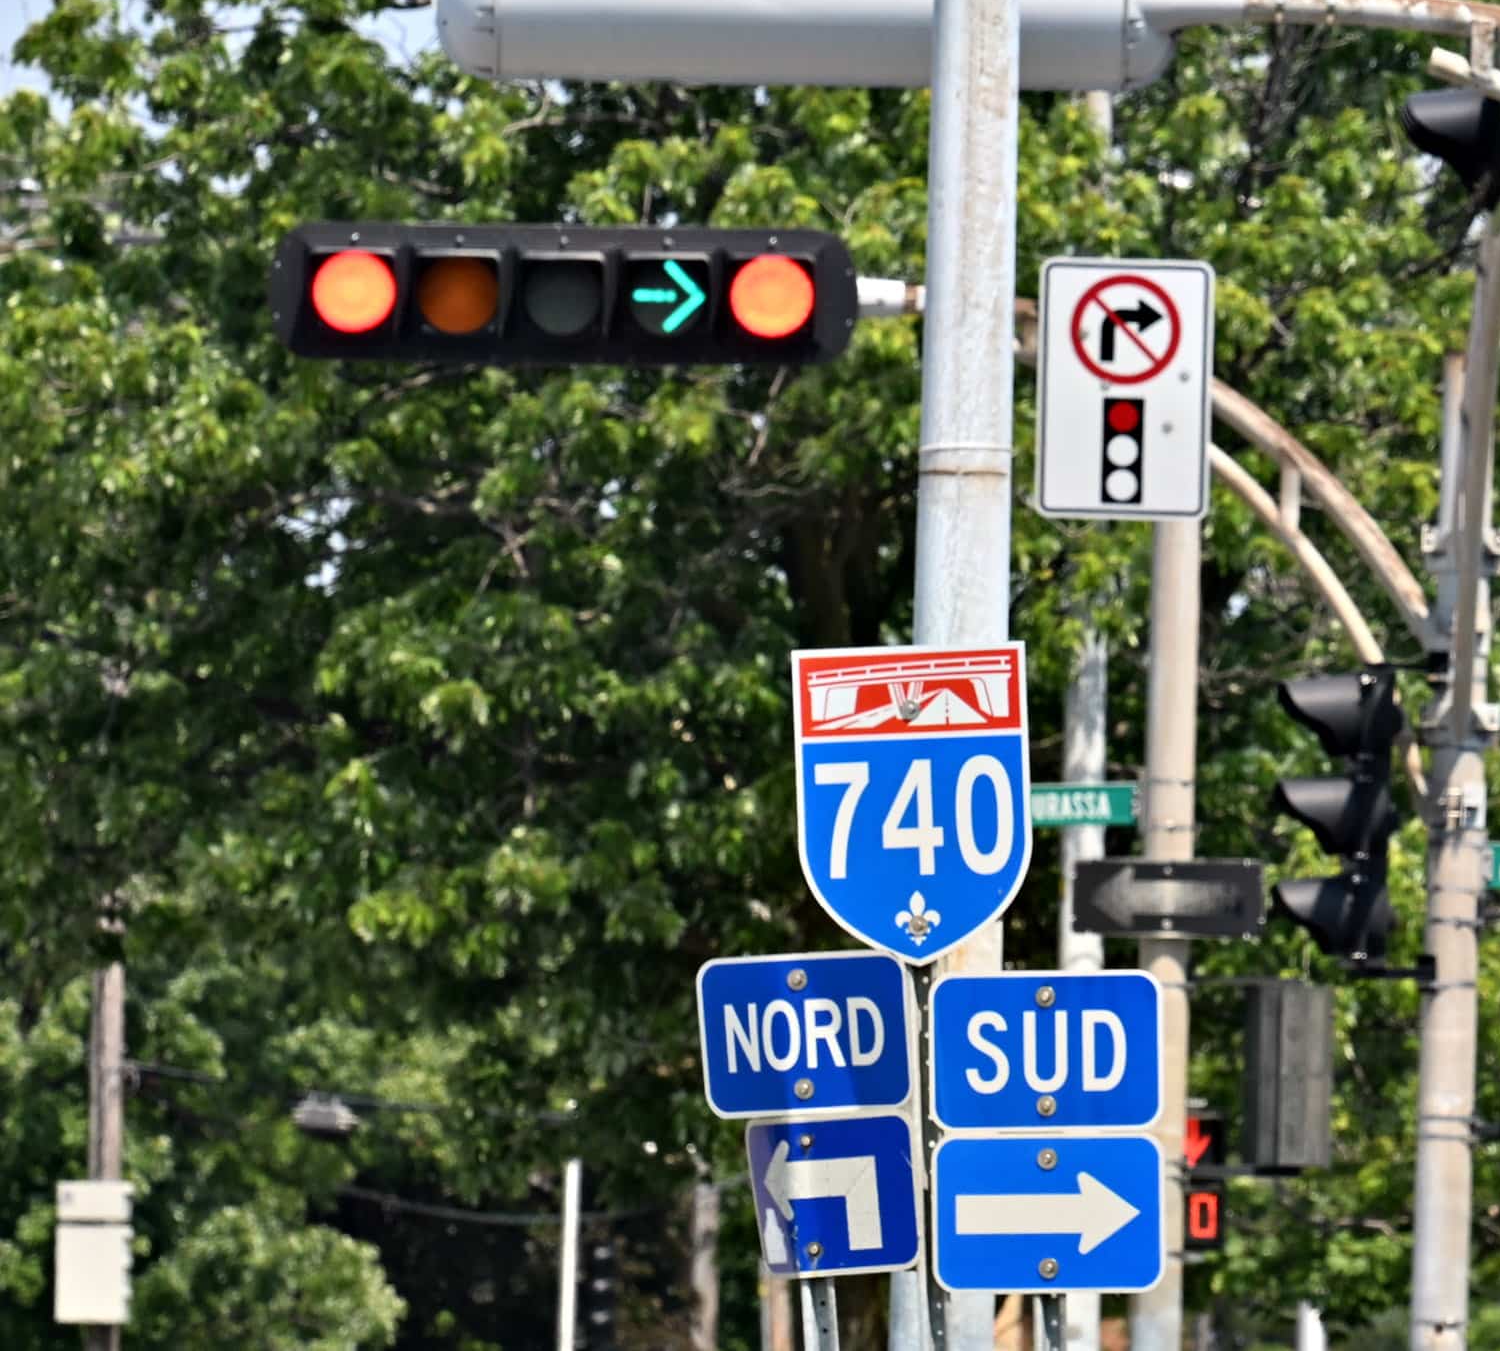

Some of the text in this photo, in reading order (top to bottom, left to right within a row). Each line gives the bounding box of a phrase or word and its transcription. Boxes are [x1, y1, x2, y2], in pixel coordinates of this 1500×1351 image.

[813, 753, 1015, 880] 740
[724, 996, 885, 1073] NORD
[966, 1008, 1127, 1094] SUD
